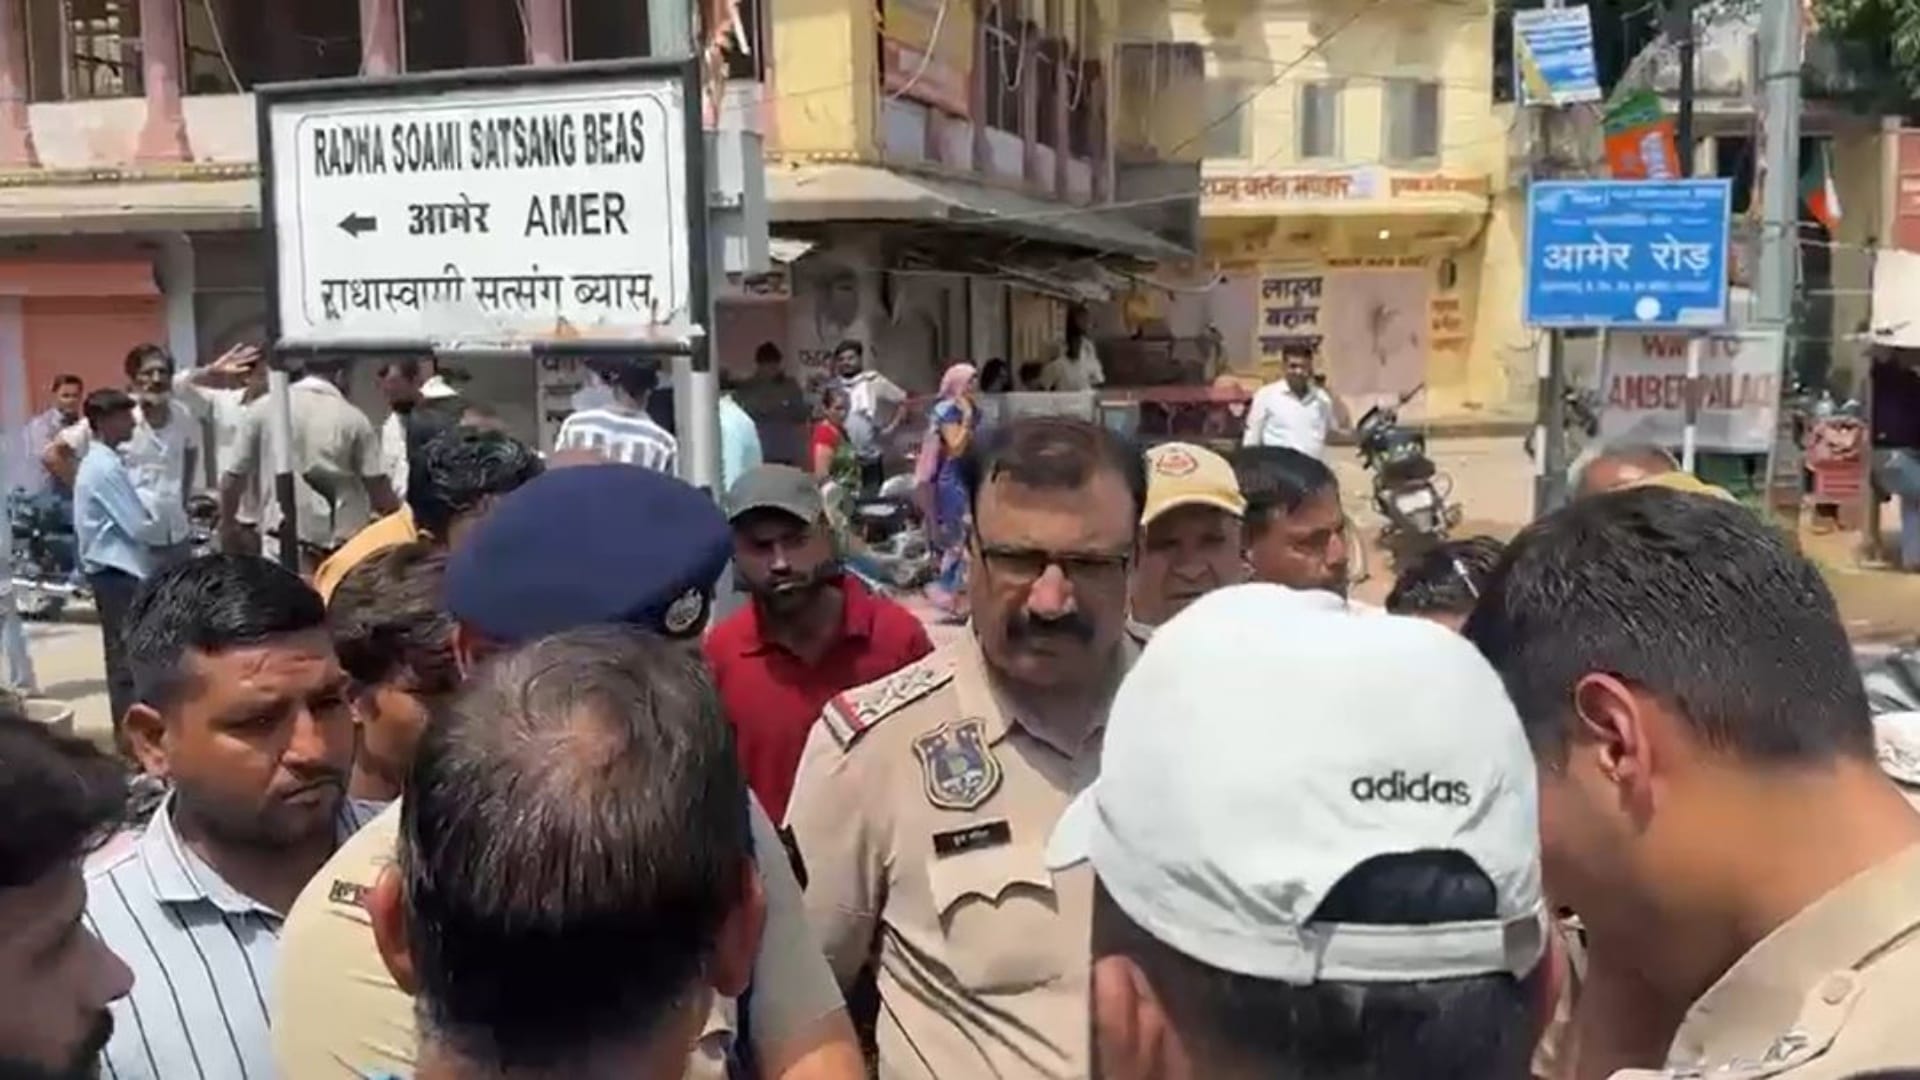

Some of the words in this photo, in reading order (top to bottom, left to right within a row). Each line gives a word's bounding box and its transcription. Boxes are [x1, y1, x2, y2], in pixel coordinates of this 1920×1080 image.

[314, 124, 387, 177] RADHA
[391, 120, 463, 172] SOAMI
[470, 112, 577, 170] SATSANG
[582, 110, 645, 165] BEAS
[408, 192, 490, 235] आमेर
[525, 192, 629, 237] AMER
[1543, 230, 1632, 272] आमेर
[473, 264, 564, 310] सत्संग
[1262, 276, 1323, 299] लाला
[1351, 770, 1471, 806] adidas
